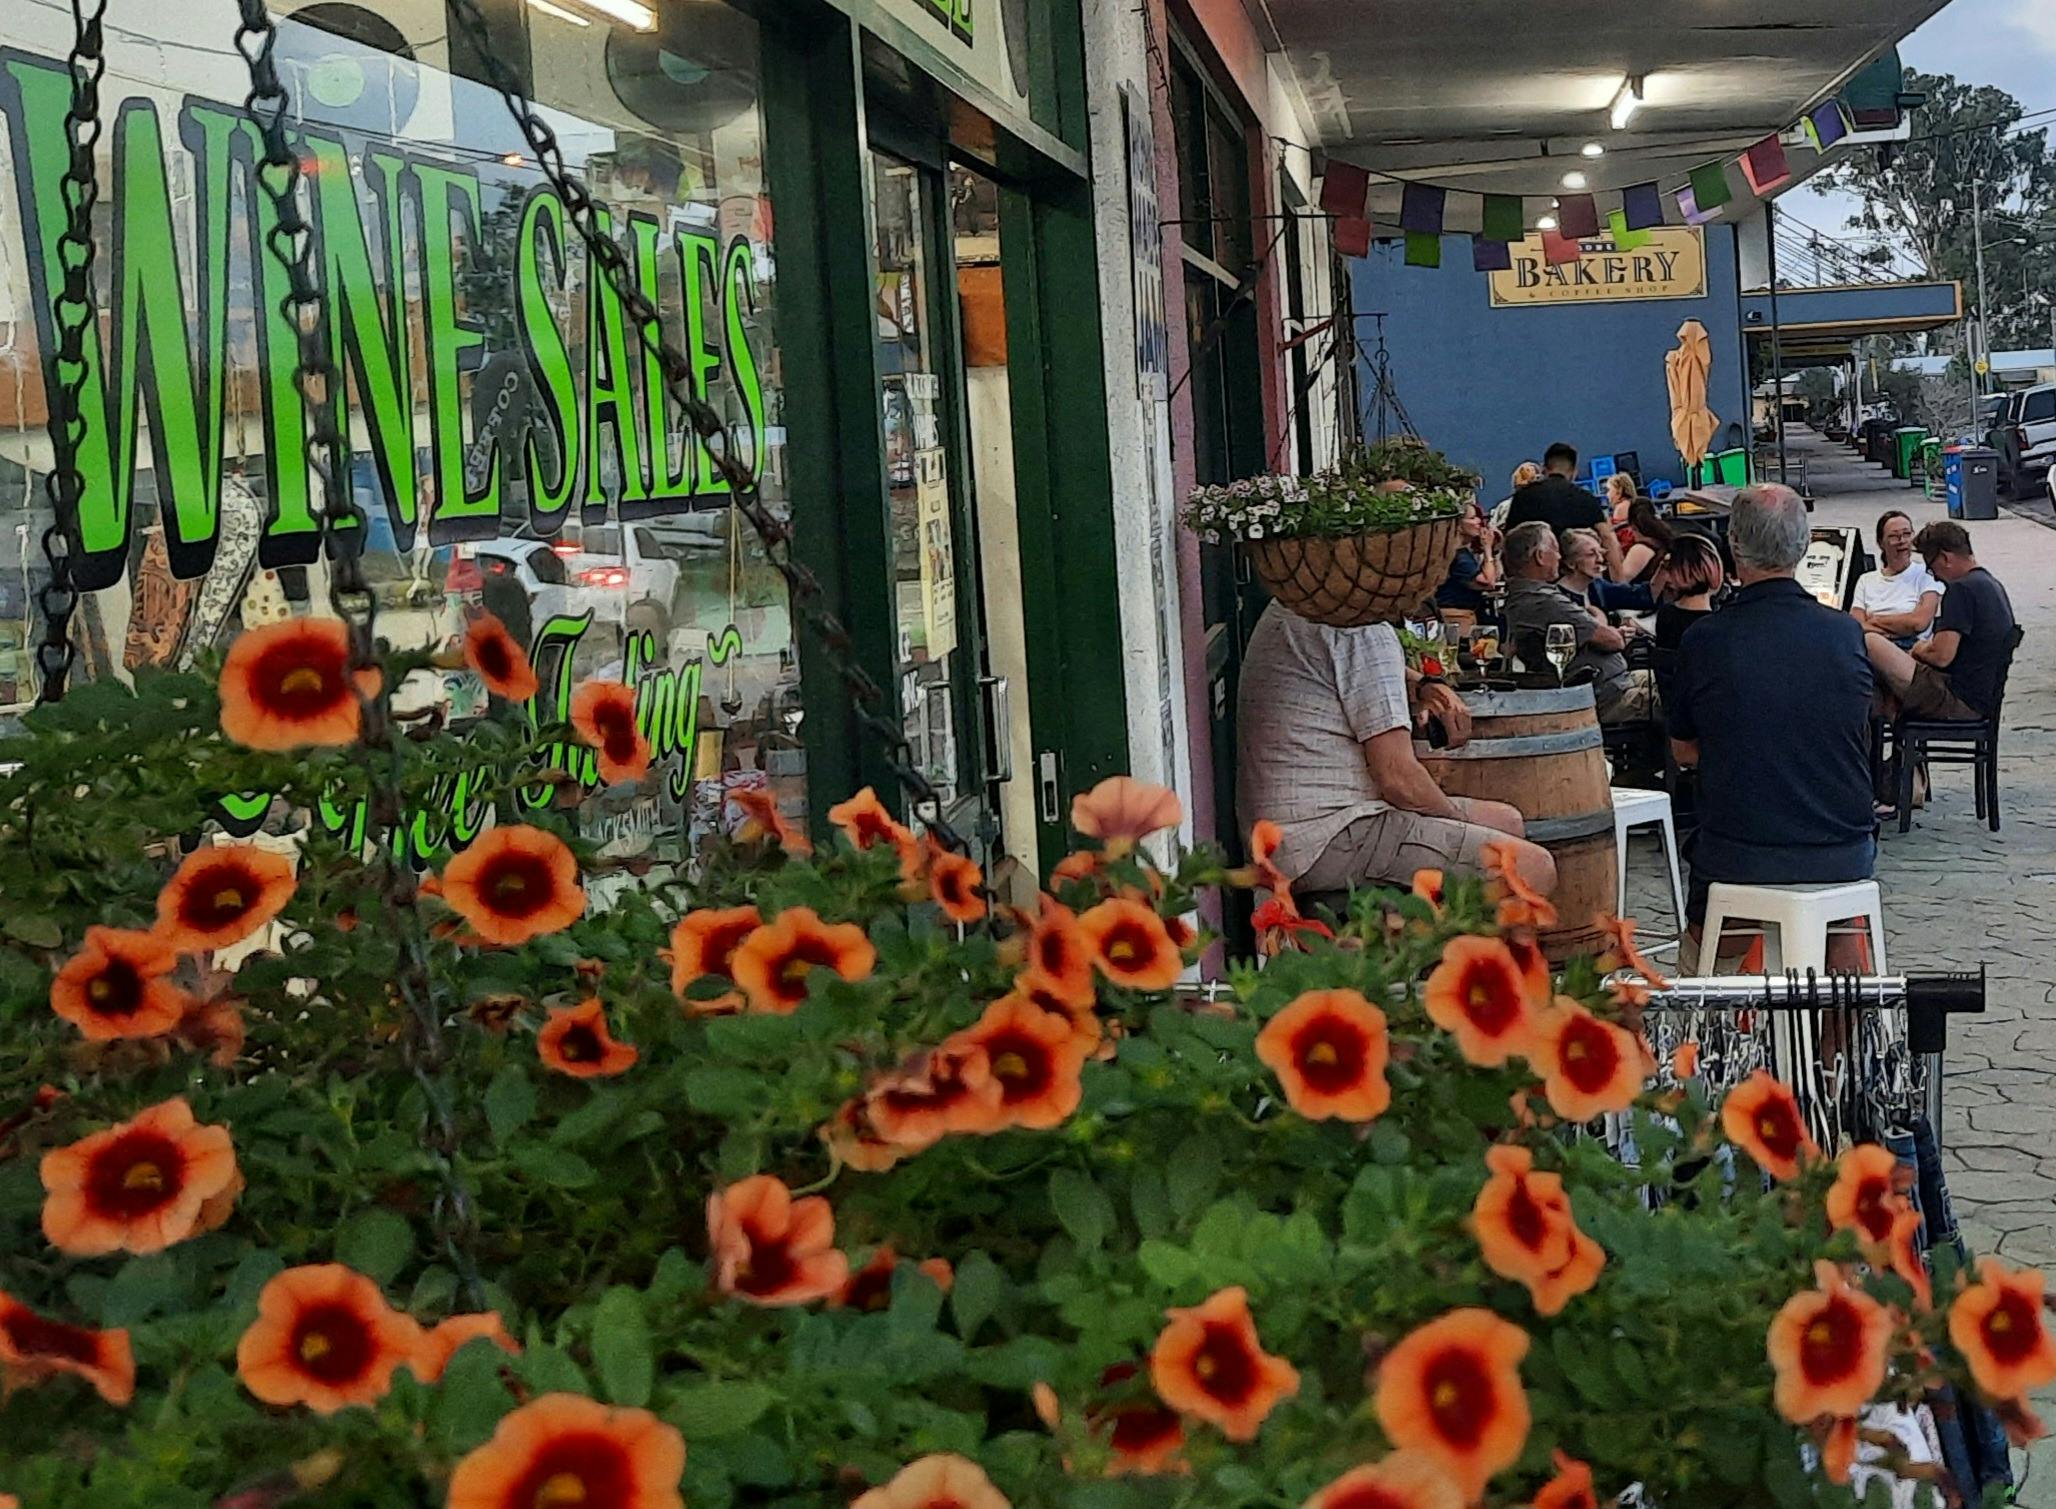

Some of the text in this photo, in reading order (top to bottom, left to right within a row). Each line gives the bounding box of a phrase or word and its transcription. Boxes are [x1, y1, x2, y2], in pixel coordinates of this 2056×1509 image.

[1515, 251, 1680, 289] BAKERY
[1549, 287, 1613, 297] COFFEE
[1625, 285, 1669, 294] SHOP
[0, 47, 767, 590] WINE SALES
